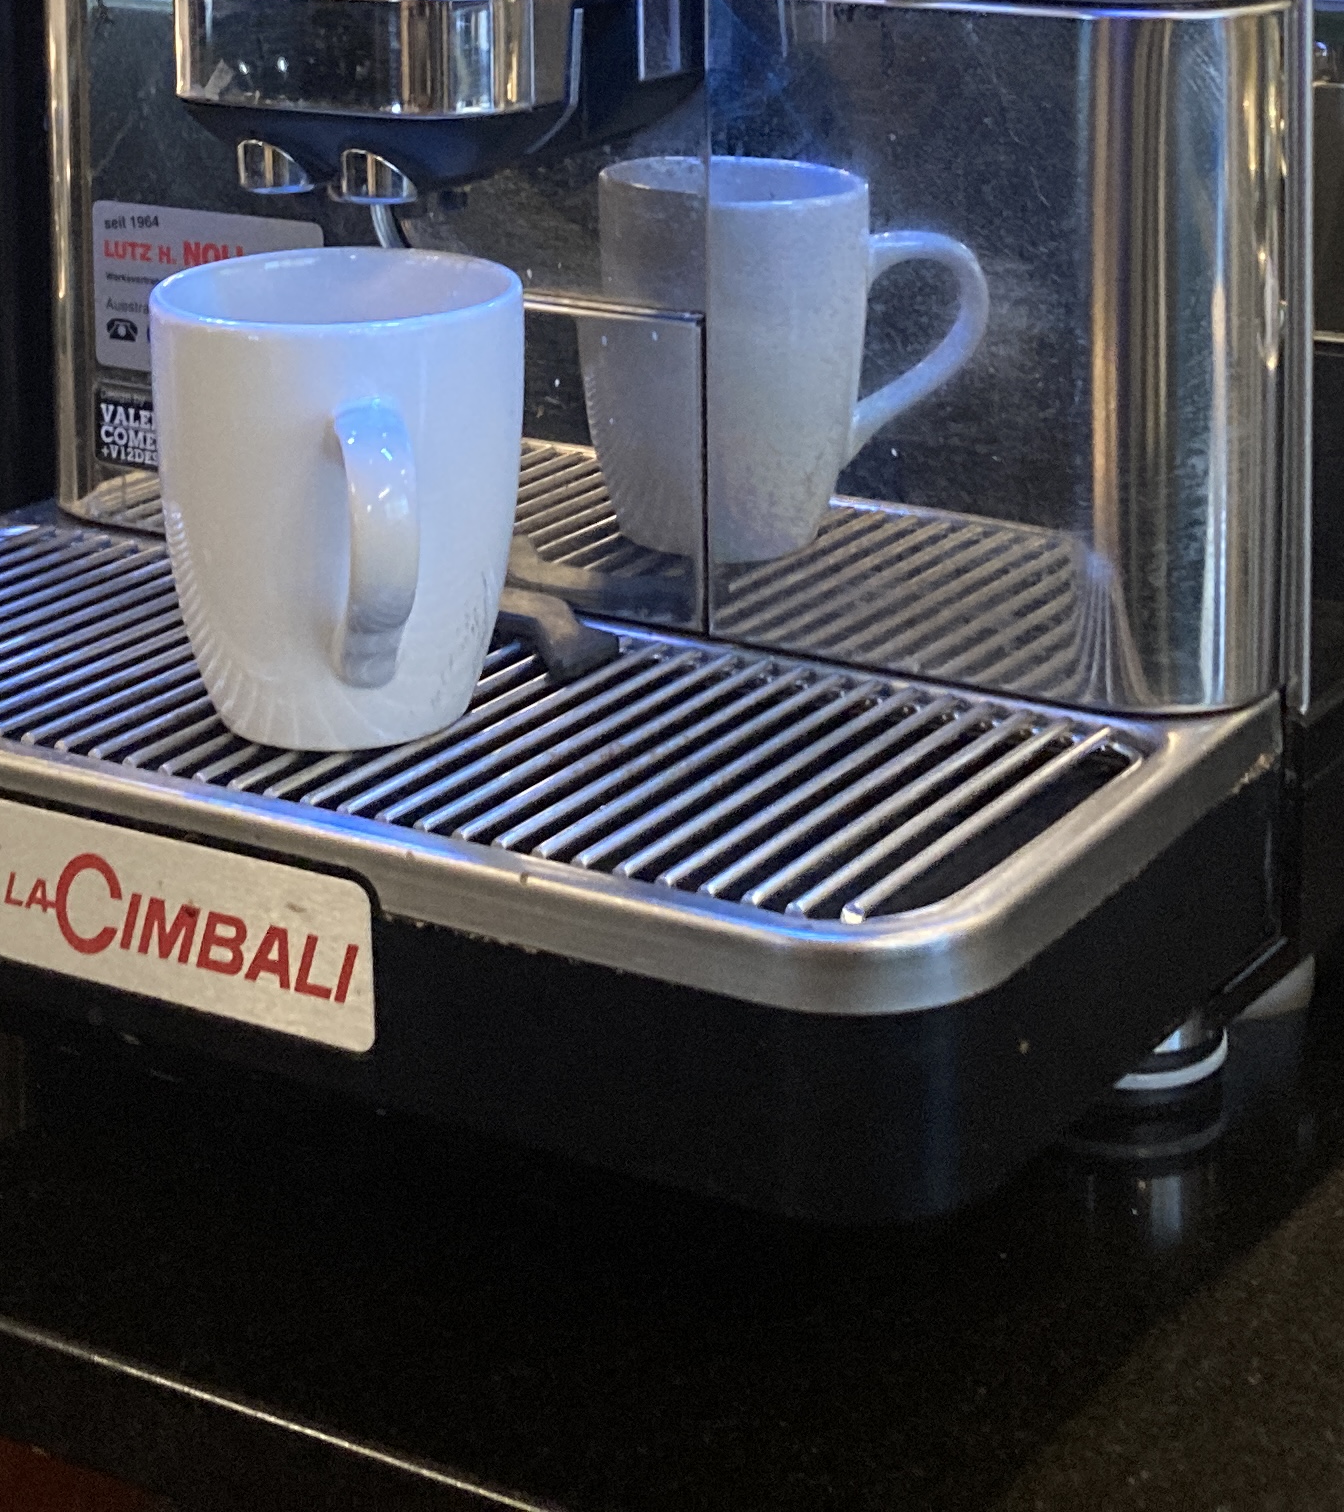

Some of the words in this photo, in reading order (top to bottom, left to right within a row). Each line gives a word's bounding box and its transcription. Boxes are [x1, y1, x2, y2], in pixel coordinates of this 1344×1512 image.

[104, 216, 127, 230] seit
[130, 215, 159, 229] 1964
[103, 240, 153, 263] LUTZ
[56, 852, 359, 1005] CIMBALI
